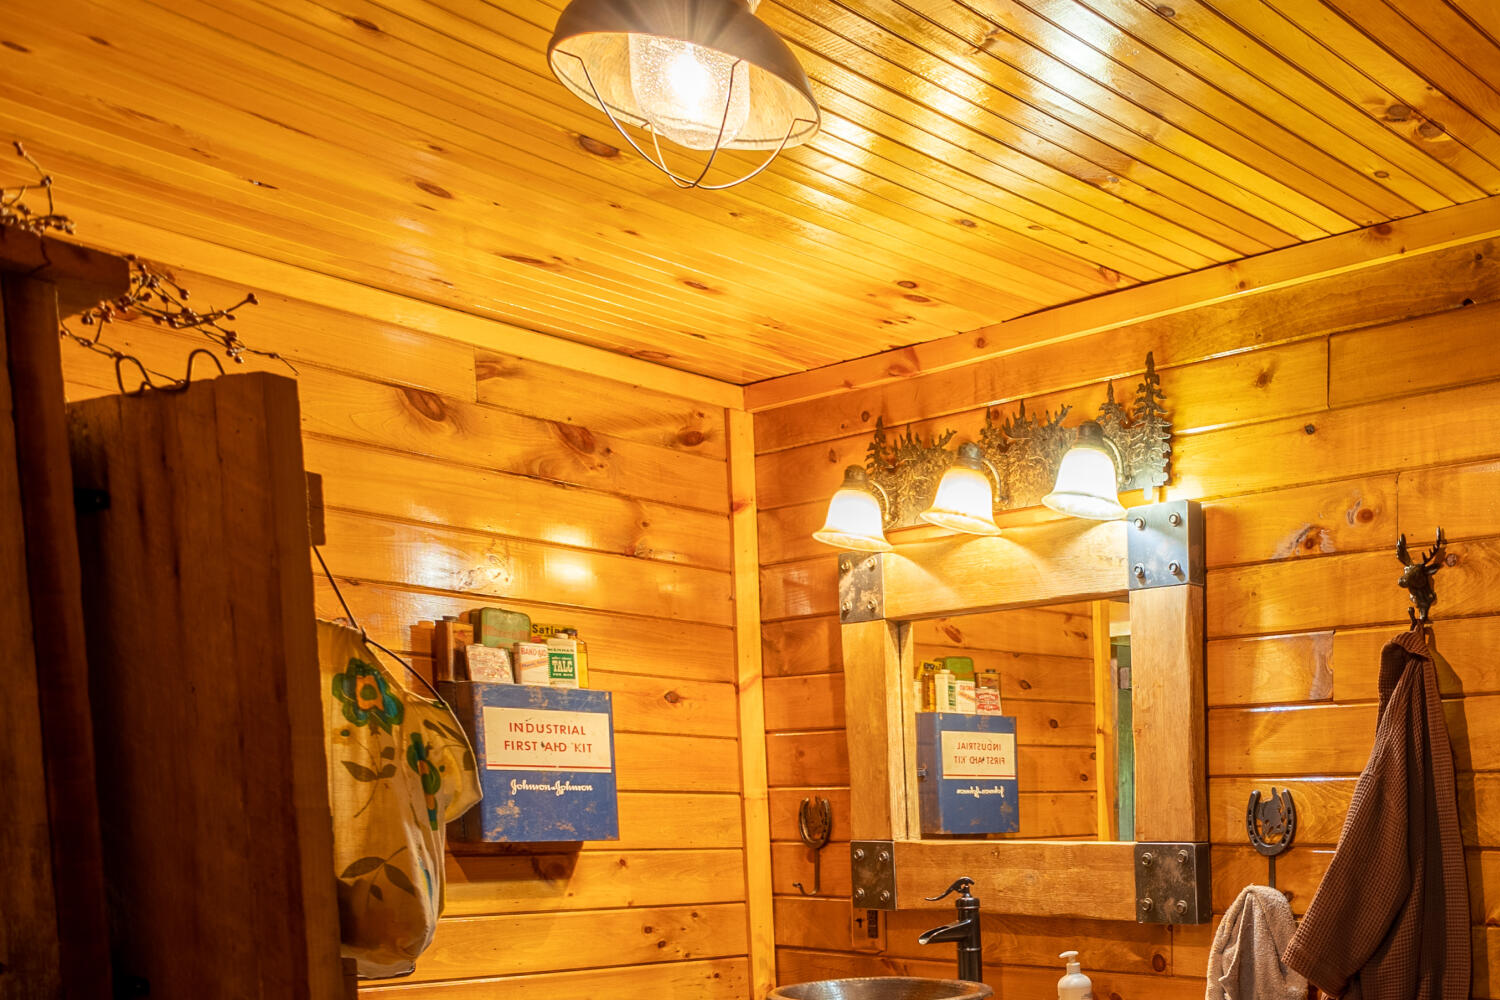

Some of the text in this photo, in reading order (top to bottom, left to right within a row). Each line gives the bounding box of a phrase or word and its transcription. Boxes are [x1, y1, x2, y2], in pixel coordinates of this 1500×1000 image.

[551, 660, 573, 673] TALC
[509, 721, 586, 736] INDUSTRIAL
[504, 740, 593, 753] FIRST AID KIT
